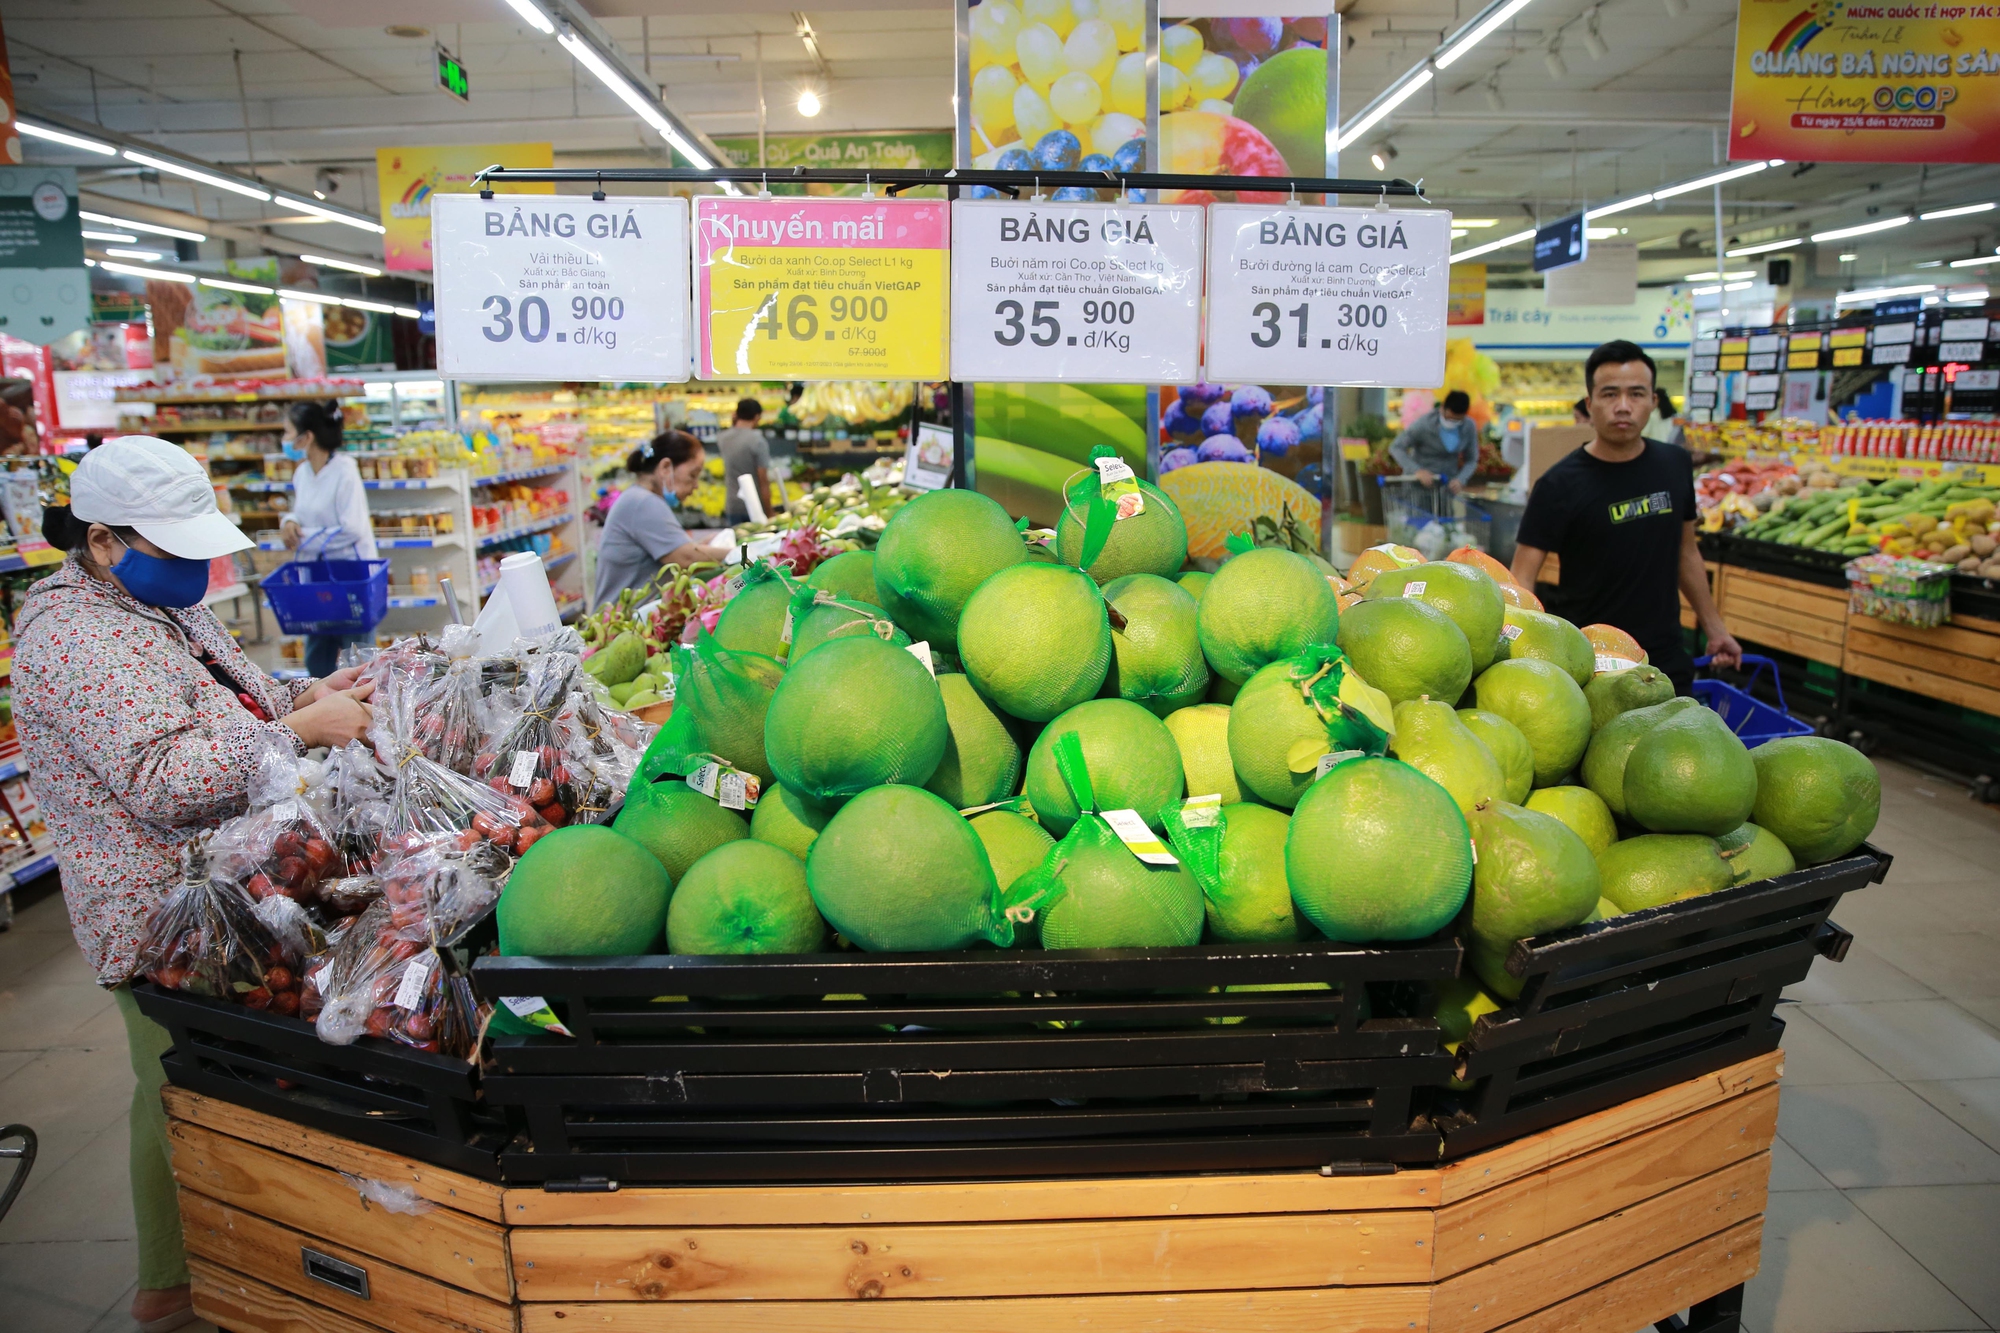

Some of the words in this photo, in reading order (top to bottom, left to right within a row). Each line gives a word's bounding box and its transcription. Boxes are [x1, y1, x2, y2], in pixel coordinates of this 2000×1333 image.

[1888, 4, 1921, 18] QUỐC
[1924, 3, 1938, 18] TẾ
[1940, 6, 1966, 20] HỢP
[1970, 5, 1993, 18] TÁC
[1750, 46, 1834, 75] QUẢNG
[1842, 50, 1875, 75] BÁ
[1882, 50, 1949, 75] NÔNG
[1786, 85, 1871, 122] Hàng
[1873, 85, 1956, 111] OCOP
[1816, 117, 1841, 128] ngày
[1866, 116, 1885, 127] đến
[1888, 117, 1935, 128] 12/7/2023
[805, 141, 841, 160] Quả
[845, 143, 869, 158] An
[875, 140, 916, 158] Toàn
[485, 207, 576, 238] BẢNG
[587, 209, 642, 239] GIÁ
[711, 210, 822, 245] Khuyến
[833, 214, 884, 240] mãi
[1000, 212, 1090, 243] BẢNG
[1101, 215, 1155, 245] GIÁ
[1259, 216, 1346, 247] BẢNG
[1357, 220, 1408, 249] GIÁ
[530, 253, 549, 264] Vải
[553, 252, 583, 264] thiều
[740, 254, 767, 266] Bưởi
[770, 256, 783, 266] da
[786, 256, 811, 266] xanh
[814, 256, 846, 268] Co.op
[849, 256, 882, 267] Select
[884, 257, 897, 267] L1
[900, 257, 913, 270] kg
[1022, 257, 1048, 269] năm
[1051, 258, 1067, 270] roi
[1070, 258, 1106, 272] Co.op
[1109, 258, 1147, 270] Select
[1150, 260, 1164, 273] kg
[523, 268, 543, 277] Xuất
[562, 268, 578, 278] Bắc
[580, 268, 606, 278] Giang
[786, 268, 804, 276] Xuất
[839, 269, 866, 278] Dương
[1272, 260, 1312, 274] đường
[1315, 260, 1326, 272] lá
[1328, 263, 1353, 274] cam
[519, 280, 538, 289] Sản
[572, 282, 585, 290] an
[587, 280, 610, 290] toàn
[733, 279, 756, 290] Sản
[759, 278, 790, 292] phẩm
[792, 280, 811, 292] đạt
[814, 280, 836, 290] tiêu
[839, 278, 872, 290] chuẩn
[875, 281, 921, 291] VietGAP
[1018, 272, 1037, 281] Xuất
[1055, 272, 1073, 282] Cần
[1074, 273, 1091, 282] Thơ
[1098, 272, 1115, 282] Việt
[1116, 274, 1137, 282] Nam
[1290, 275, 1310, 284] Xuất
[986, 283, 1006, 294] Sản
[1008, 282, 1036, 295] phẩm
[1038, 284, 1054, 296] đạt
[1057, 284, 1076, 294] tiêu
[1078, 284, 1109, 294] chuẩn
[1251, 285, 1270, 295] Sản
[1272, 286, 1300, 298] phẩm
[1302, 286, 1318, 298] đạt
[1320, 287, 1338, 298] tiêu
[1340, 286, 1370, 298] chuẩn
[571, 296, 624, 320] 900
[830, 295, 888, 322] 900
[1083, 300, 1135, 324] 900
[1337, 303, 1388, 328] 300
[573, 326, 617, 350] đ/kg
[842, 327, 877, 343] đ/Kg
[1084, 330, 1130, 354] đ/Kg
[1337, 333, 1379, 356] đ/kg
[1105, 463, 1125, 472] Selec
[508, 996, 534, 1006] Selec
